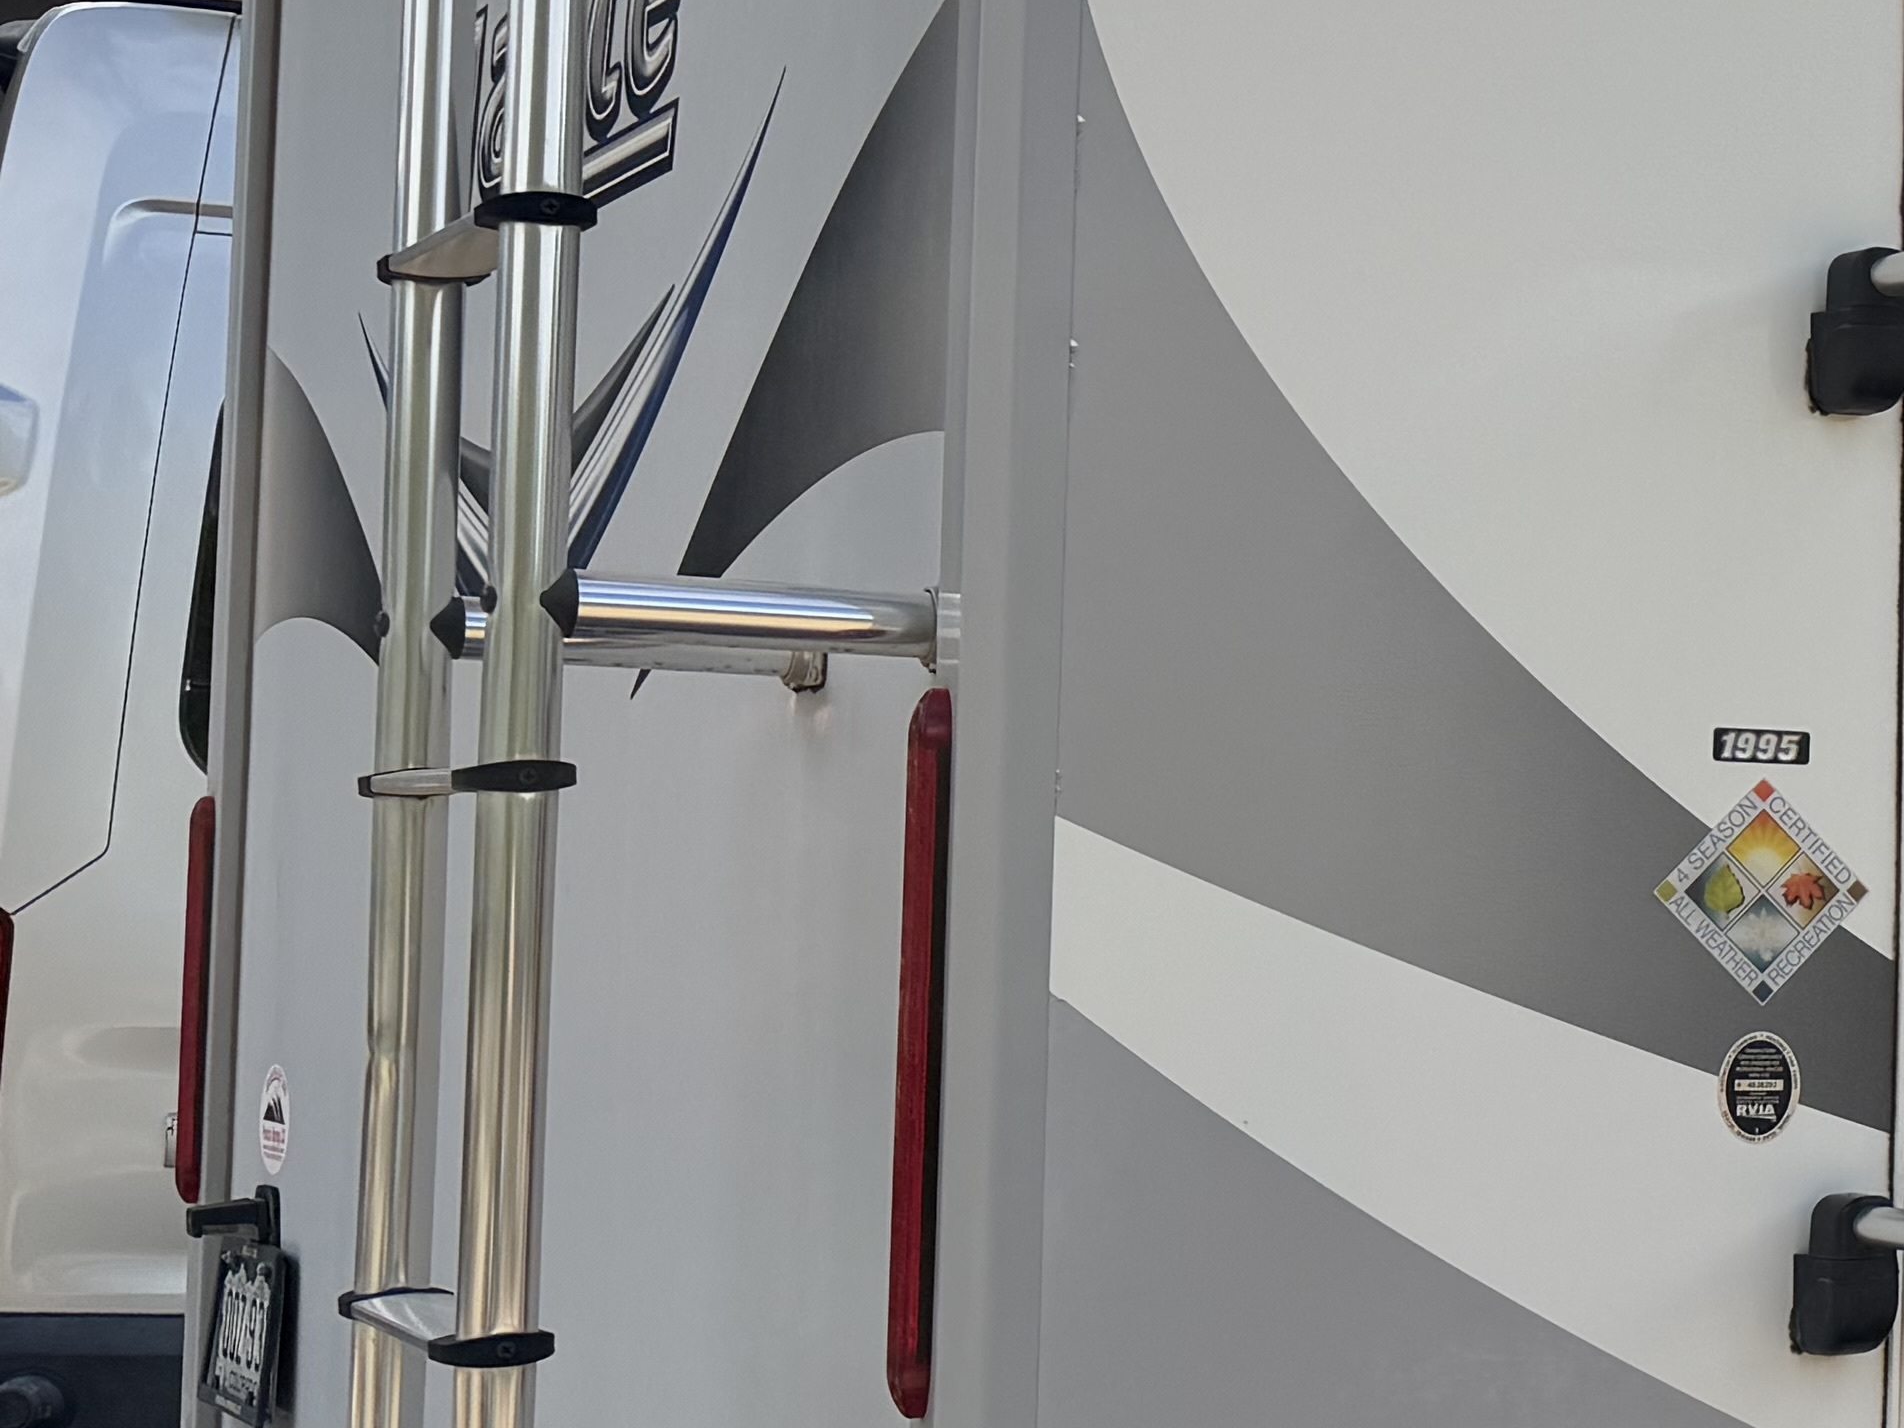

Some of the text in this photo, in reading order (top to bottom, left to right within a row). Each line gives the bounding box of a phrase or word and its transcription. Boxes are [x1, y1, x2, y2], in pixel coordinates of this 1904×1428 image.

[1720, 731, 1802, 761] 1995
[1676, 796, 1758, 883] 4 SEASON
[1769, 796, 1852, 885] CERTIFIED
[1669, 895, 1759, 987] ALL WEATHER
[1767, 892, 1855, 986] RECREATION
